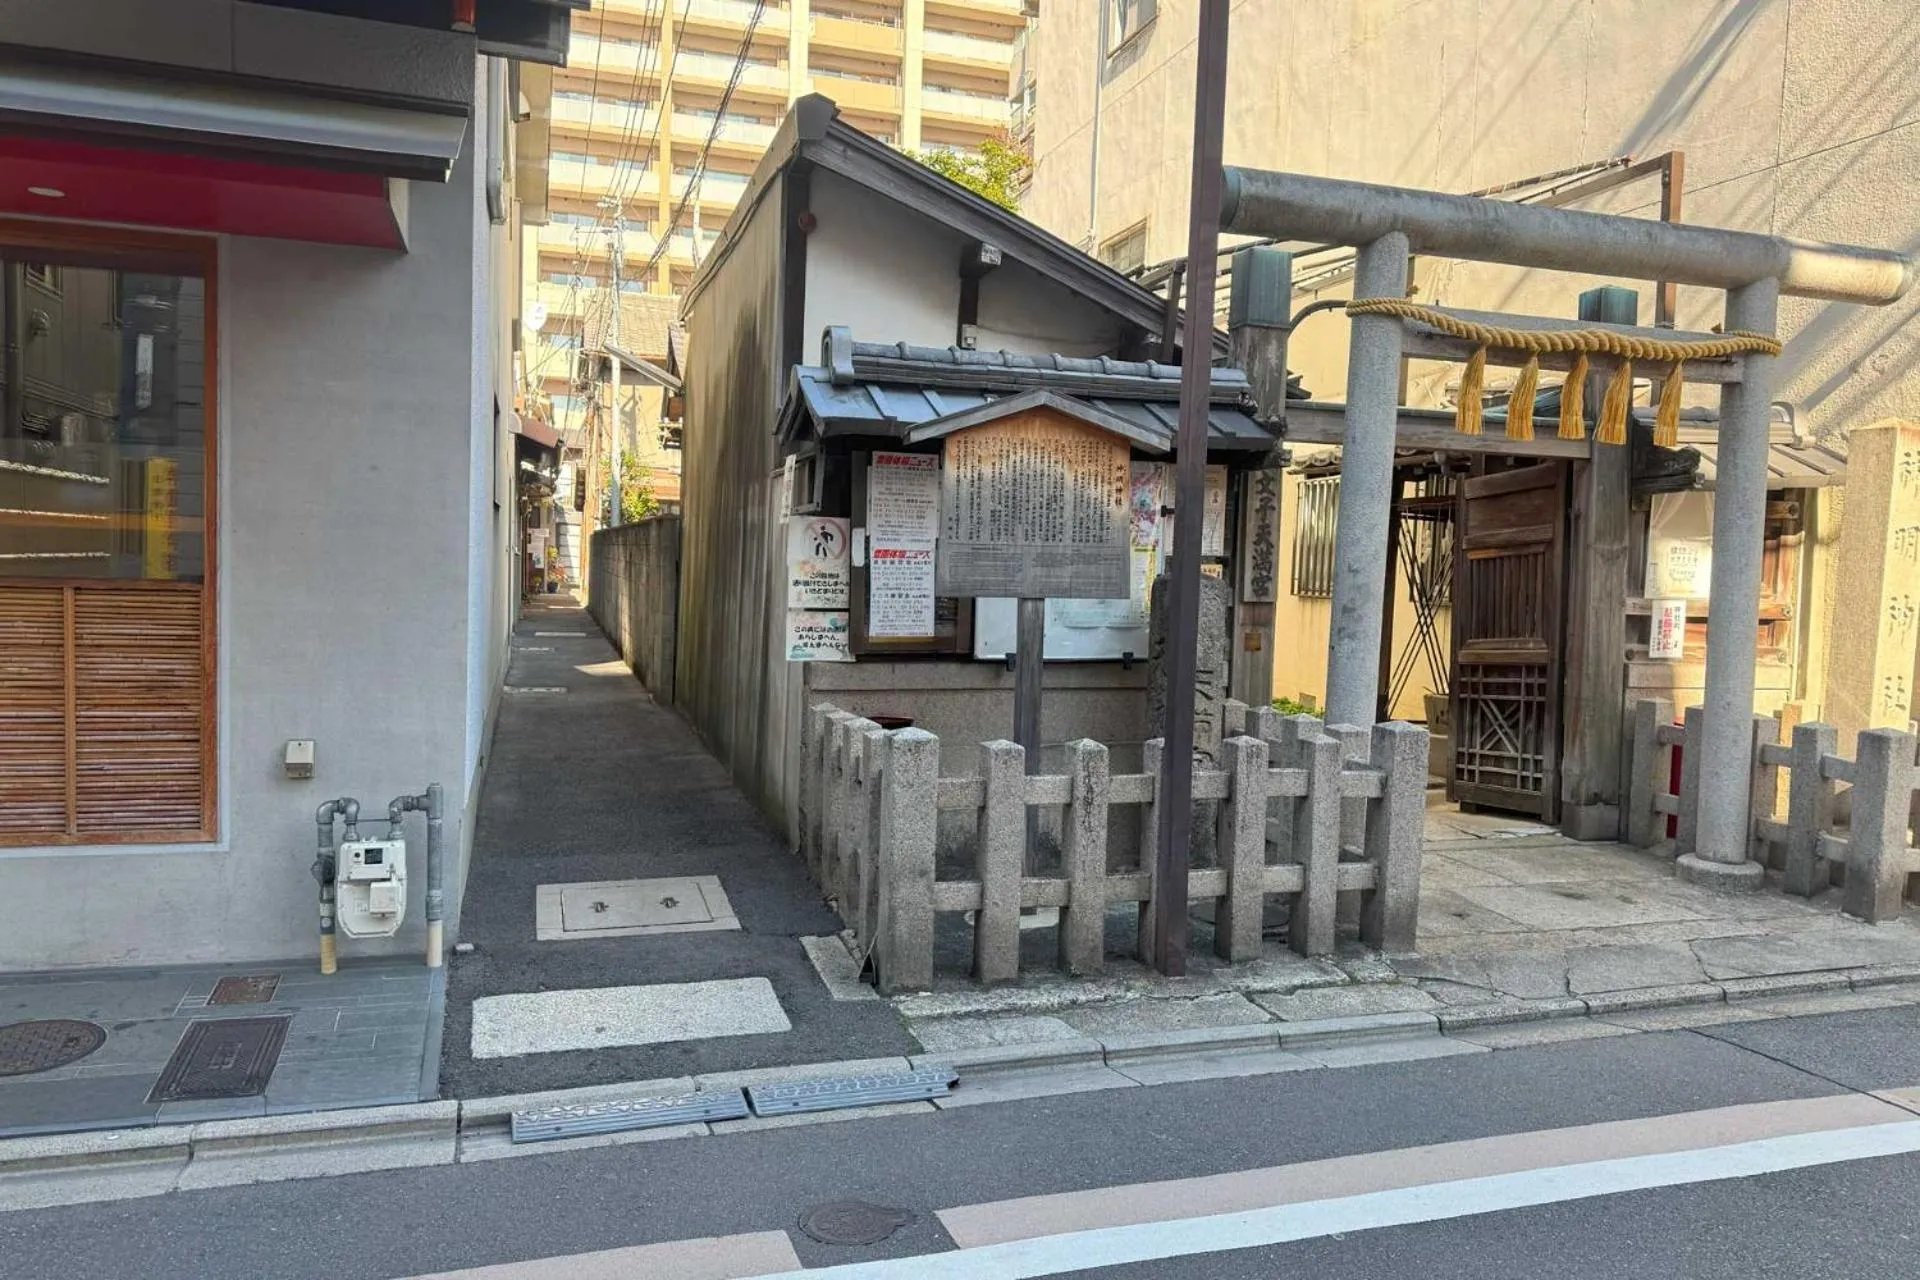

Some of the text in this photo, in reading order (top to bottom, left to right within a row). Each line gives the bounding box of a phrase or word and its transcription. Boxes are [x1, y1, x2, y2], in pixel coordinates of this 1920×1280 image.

[1251, 471, 1276, 597] 文子天満宮
